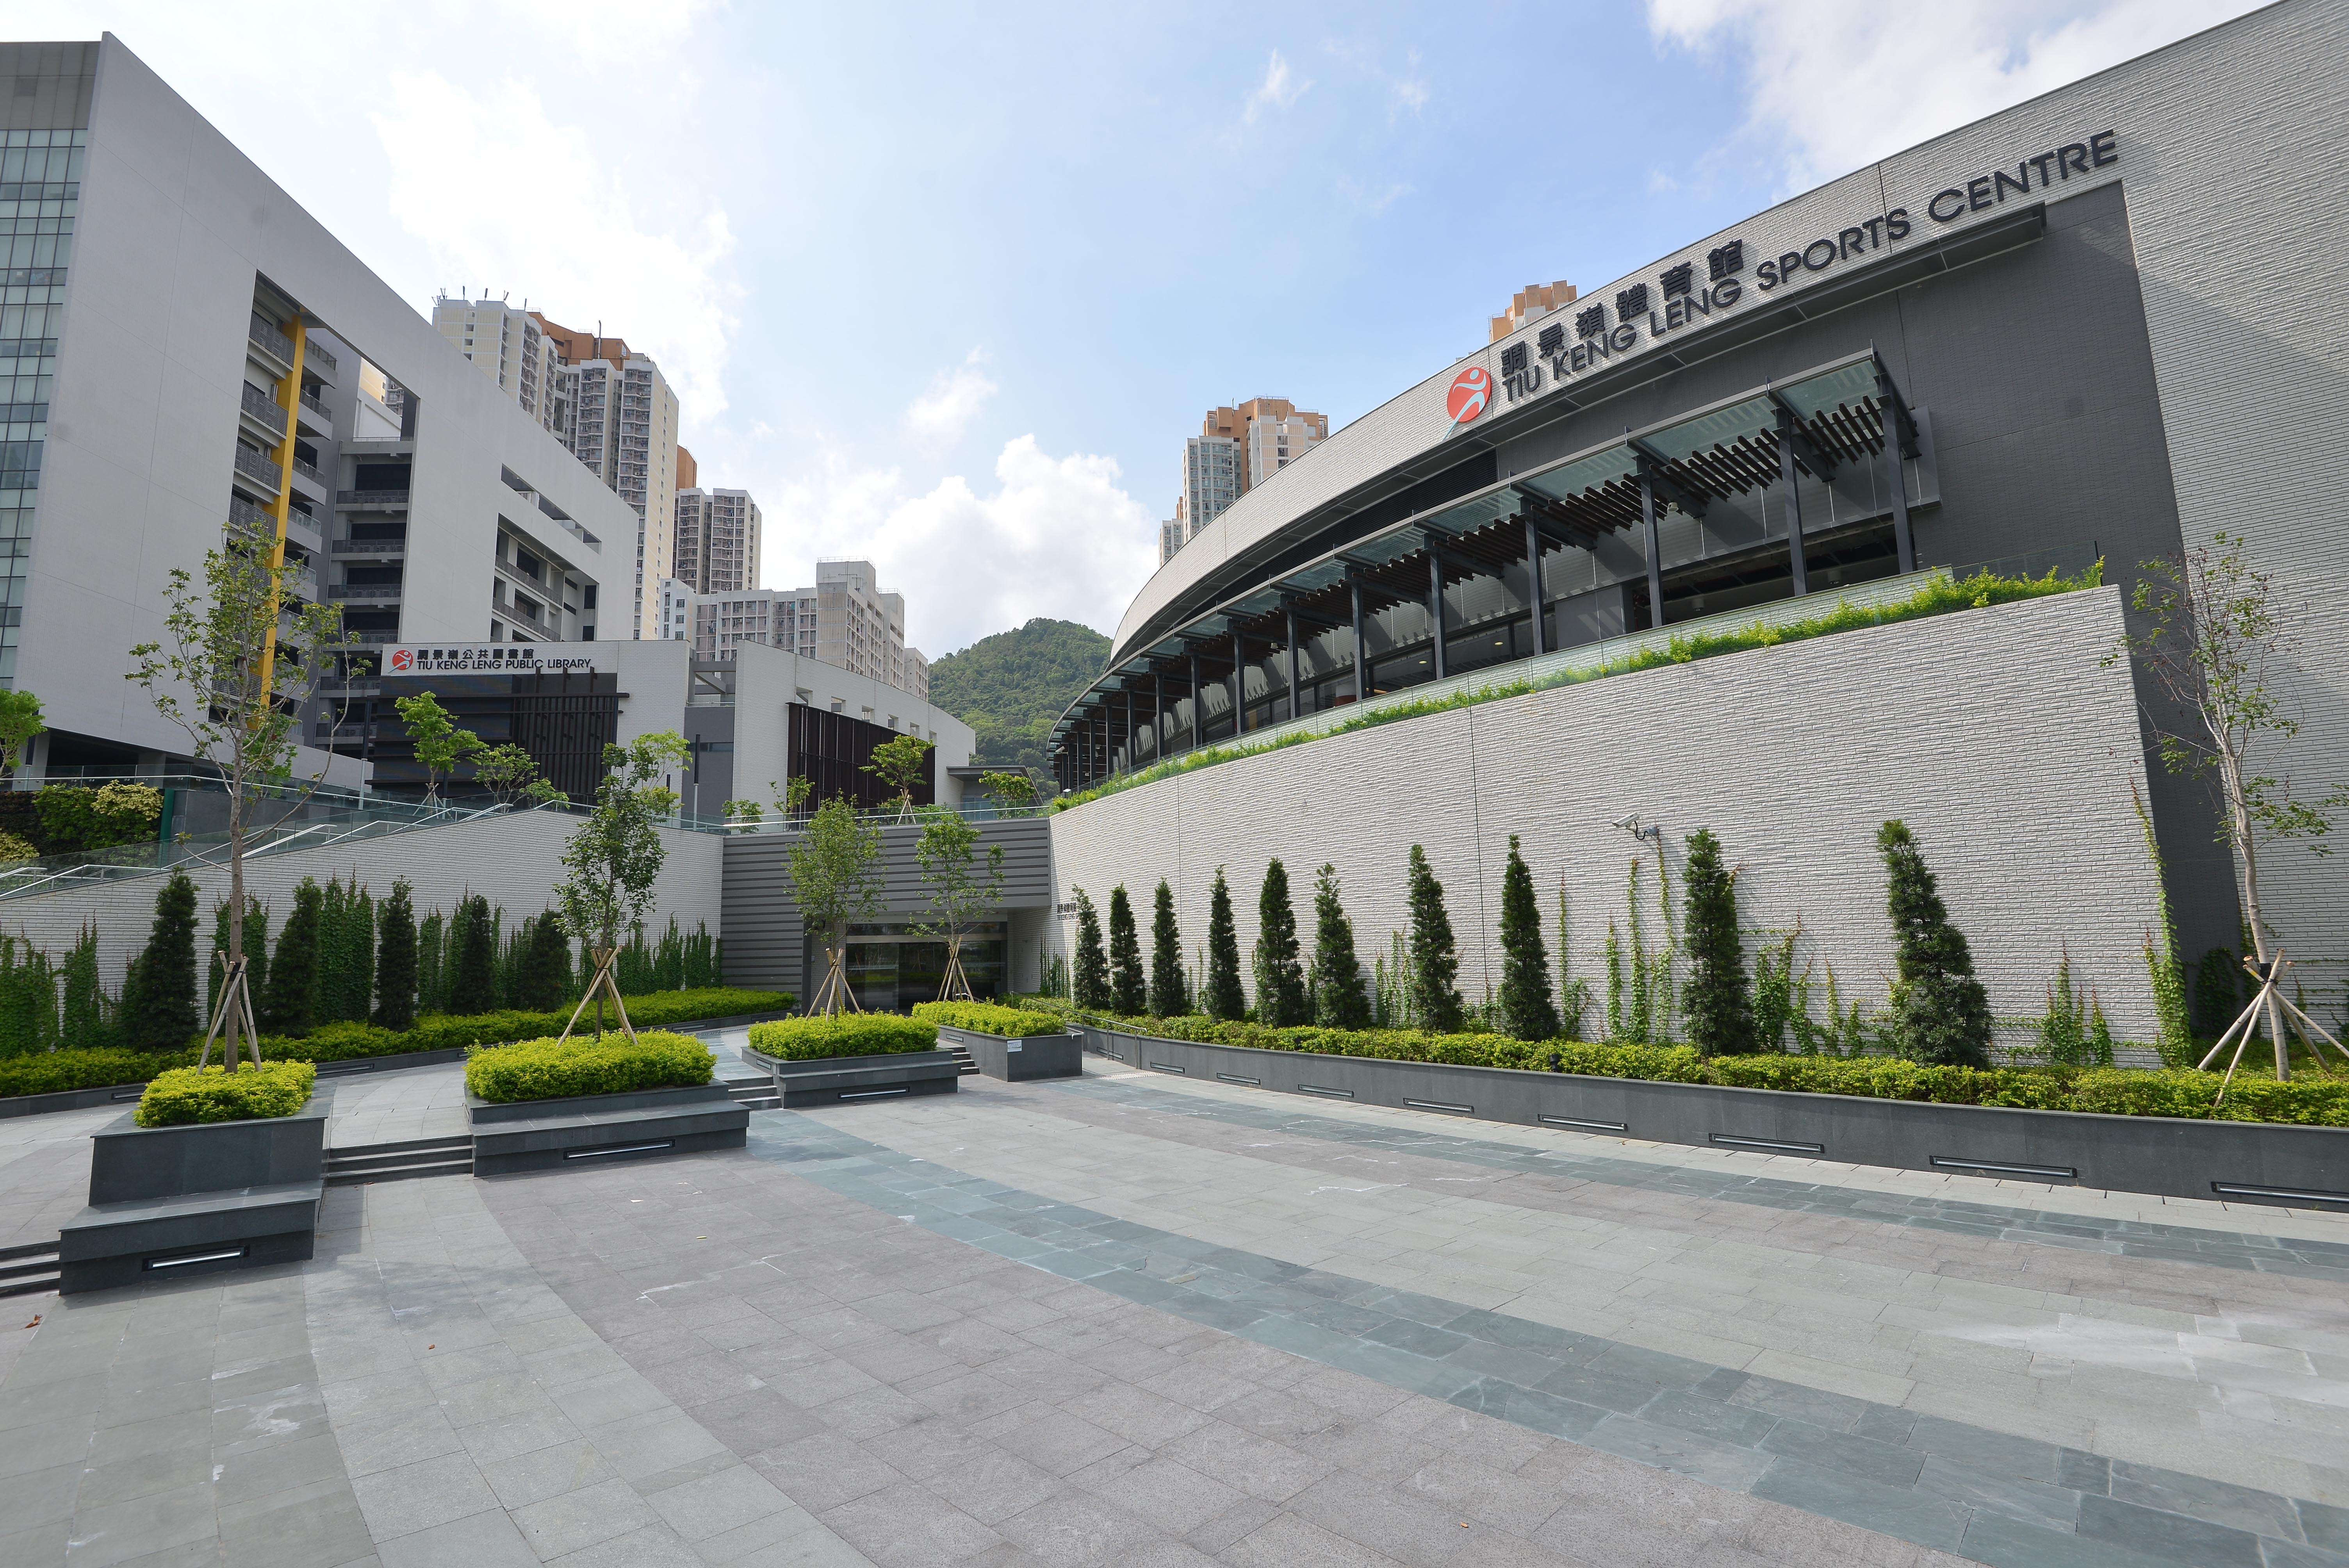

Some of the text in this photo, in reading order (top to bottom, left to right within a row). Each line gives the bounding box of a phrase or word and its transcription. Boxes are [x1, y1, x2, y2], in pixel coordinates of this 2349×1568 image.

[1501, 239, 1744, 378] 調景嶺體育館
[1502, 129, 2118, 402] TIU KENG LENG SPORTS CENTRE
[417, 659, 591, 670] TIU KENG LENG PUBLIC LIBRARY
